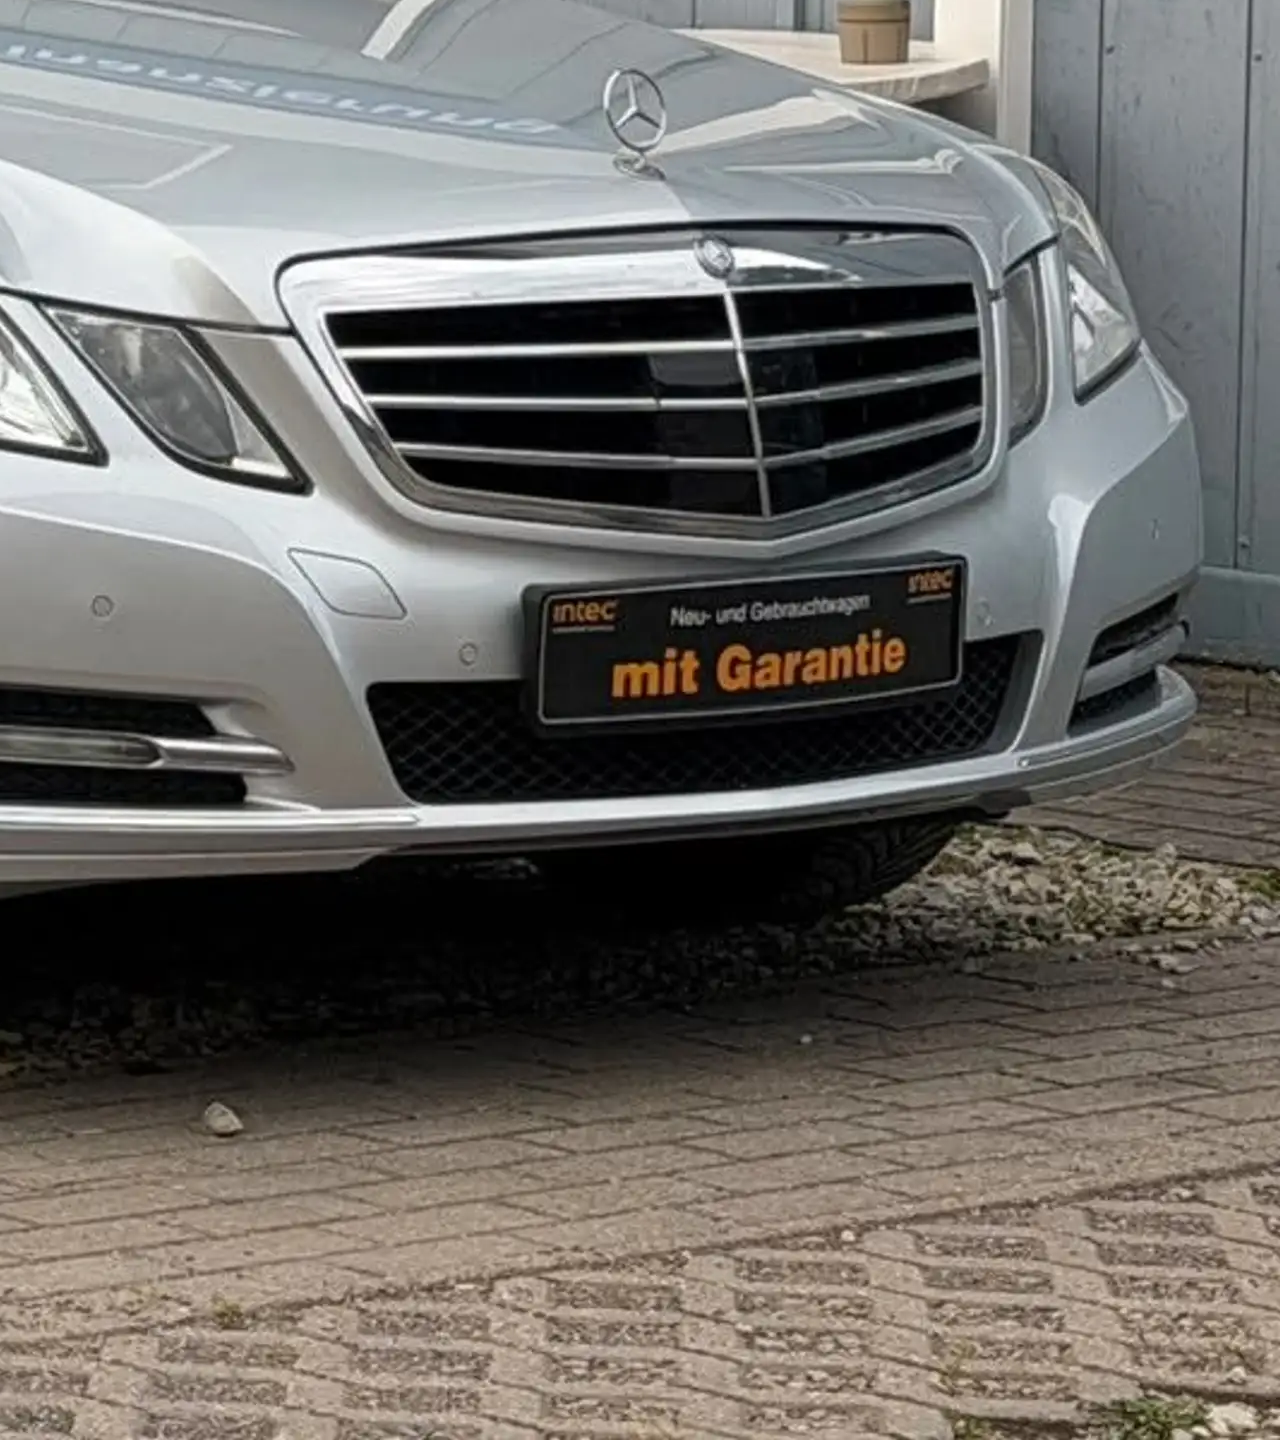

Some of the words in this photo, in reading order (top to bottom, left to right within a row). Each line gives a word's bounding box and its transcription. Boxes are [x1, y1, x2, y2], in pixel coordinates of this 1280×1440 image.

[670, 606, 712, 627] Neu-
[716, 603, 747, 625] und
[750, 594, 871, 622] Gebrauchtwagen
[611, 647, 700, 698] mit
[716, 629, 907, 693] Garantie
